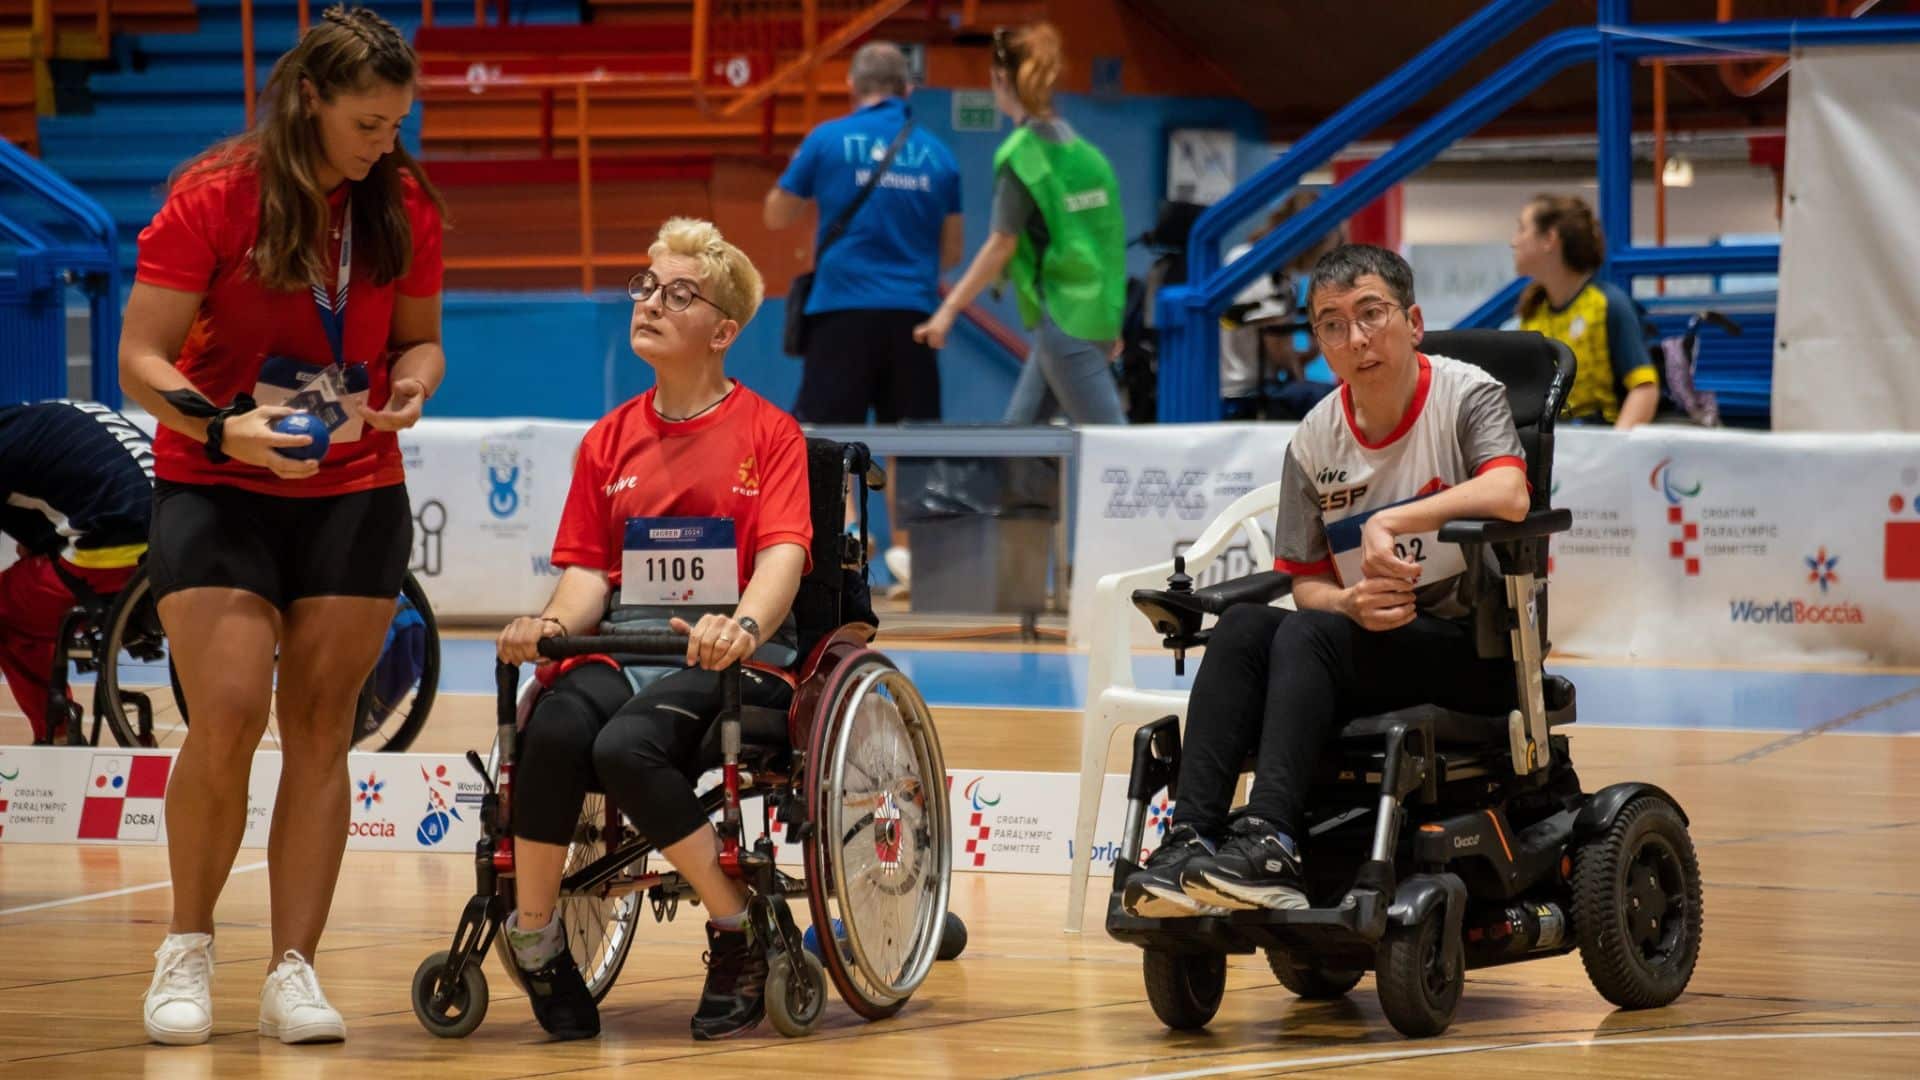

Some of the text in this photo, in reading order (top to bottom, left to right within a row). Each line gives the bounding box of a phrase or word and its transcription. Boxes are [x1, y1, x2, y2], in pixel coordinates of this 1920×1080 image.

[1319, 484, 1369, 511] ESP
[1702, 506, 1756, 519] CROATIAN
[1703, 525, 1778, 538] PARALYMPIC
[646, 557, 704, 582] 1106
[1730, 600, 1864, 624] WorldBoccia
[14, 789, 54, 798] CROATIAN
[12, 802, 67, 812] PARALYMPIC
[9, 815, 55, 825] COMMITTEE
[125, 814, 155, 825] DCBA
[996, 816, 1039, 825] CROATIAN
[993, 830, 1053, 841] PARALYMPIC
[991, 844, 1041, 854] COMMITTEE
